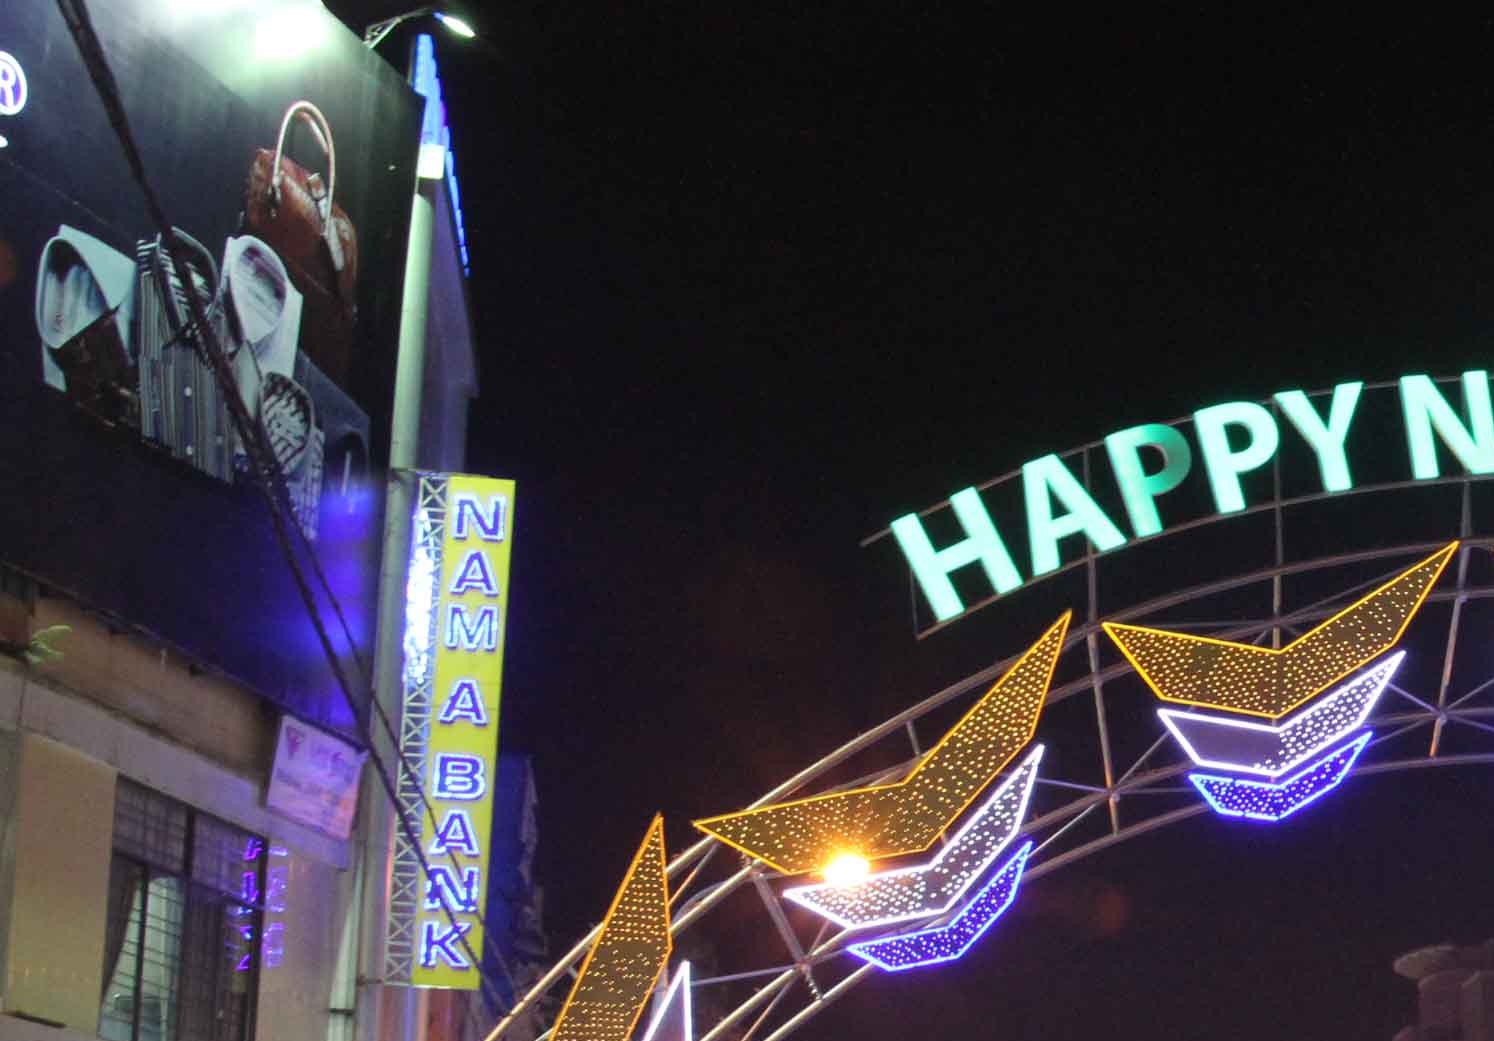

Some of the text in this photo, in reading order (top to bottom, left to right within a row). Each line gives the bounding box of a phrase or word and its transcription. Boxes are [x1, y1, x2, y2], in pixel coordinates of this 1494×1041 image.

[442, 492, 507, 653] NAM
[890, 380, 1364, 622] HAPPY
[417, 752, 489, 972] BANK
